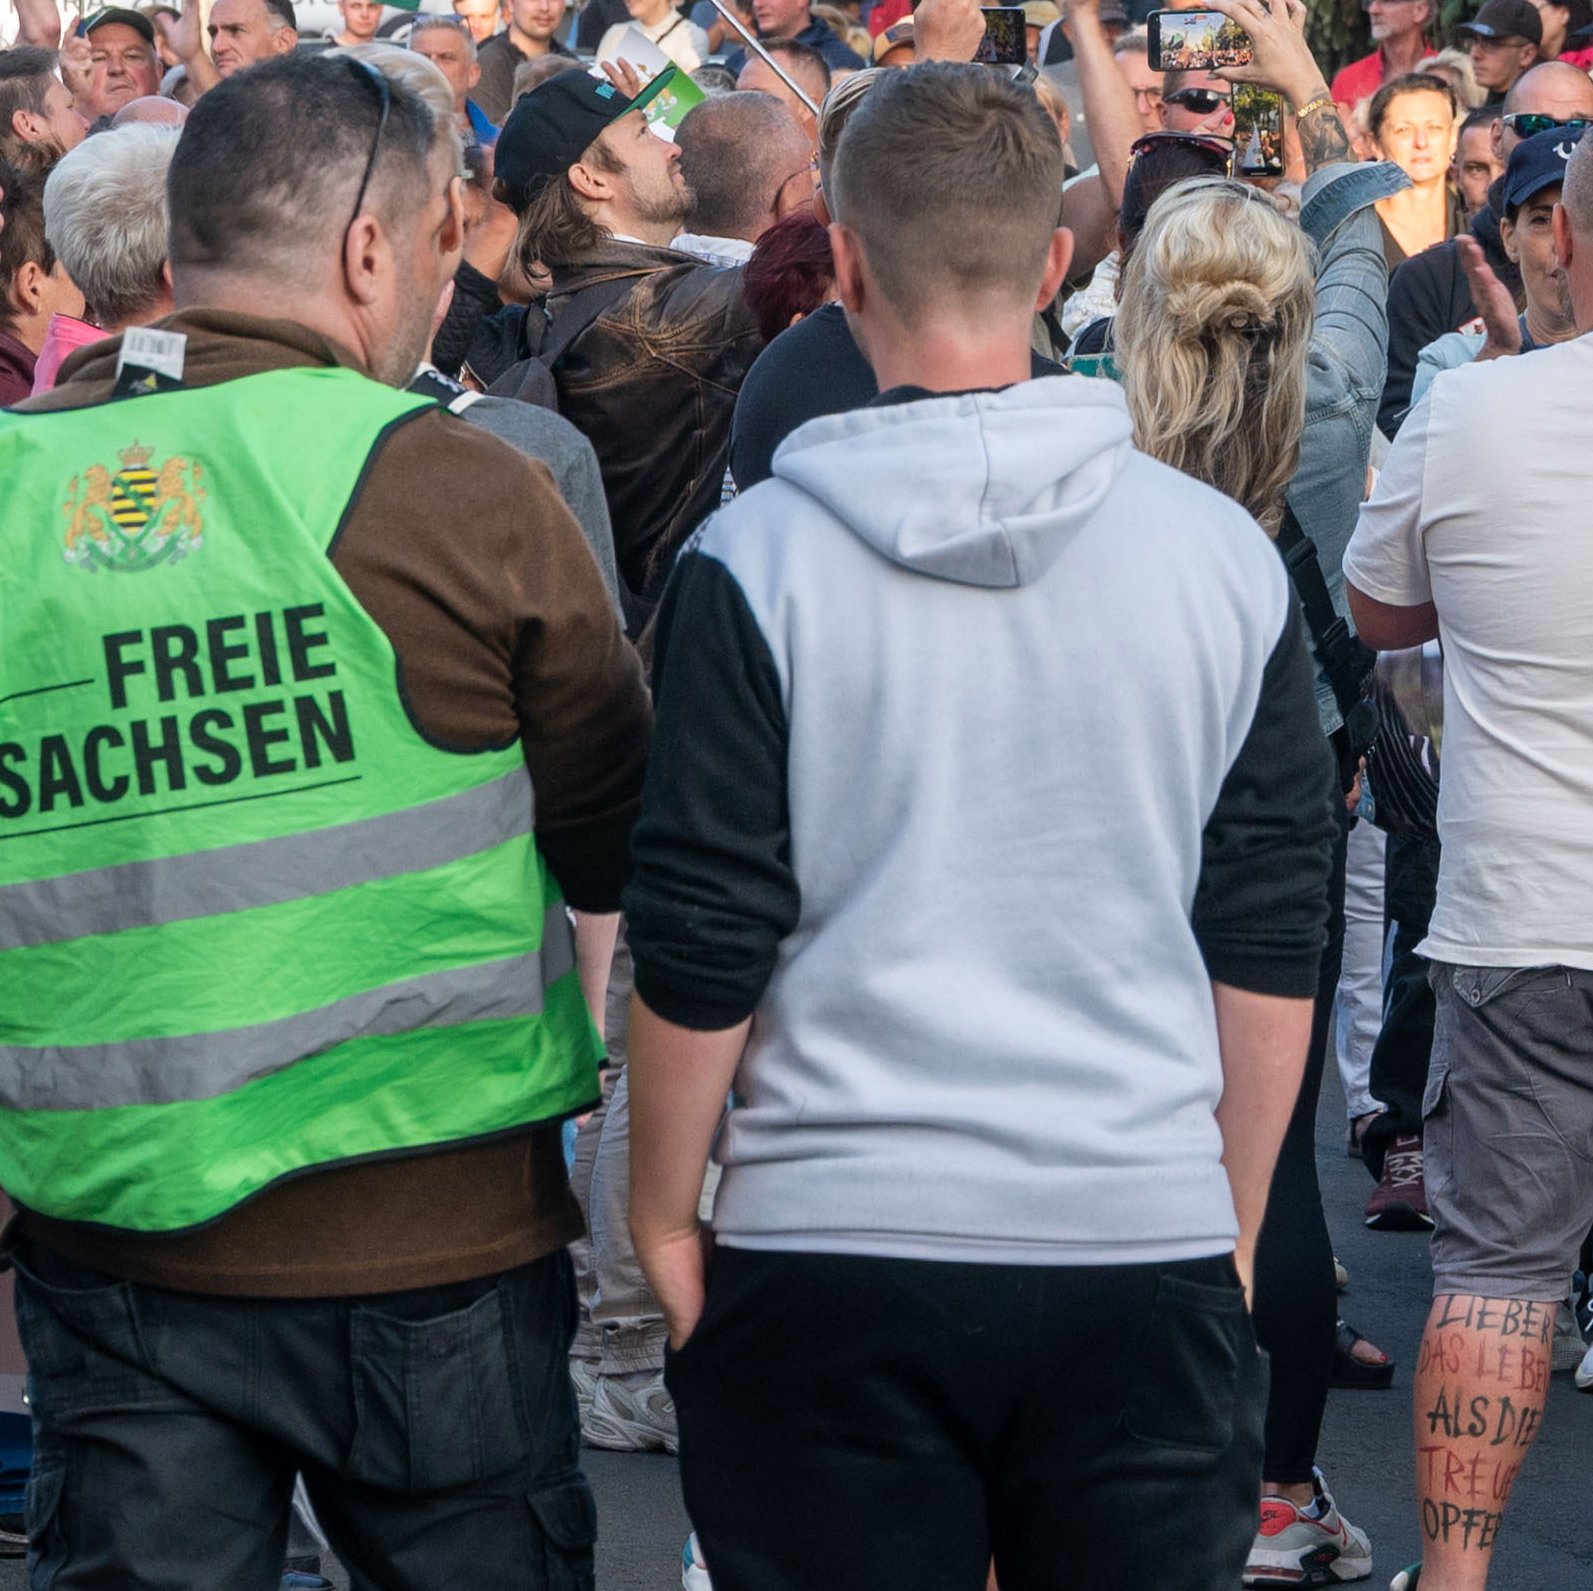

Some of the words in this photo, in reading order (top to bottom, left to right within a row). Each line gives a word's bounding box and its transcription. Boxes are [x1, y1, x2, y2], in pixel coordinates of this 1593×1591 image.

[101, 603, 338, 710] FREIE
[1436, 1294, 1551, 1345] LIEBER
[1418, 1330, 1465, 1376] DAS
[1426, 1385, 1490, 1438] ALS
